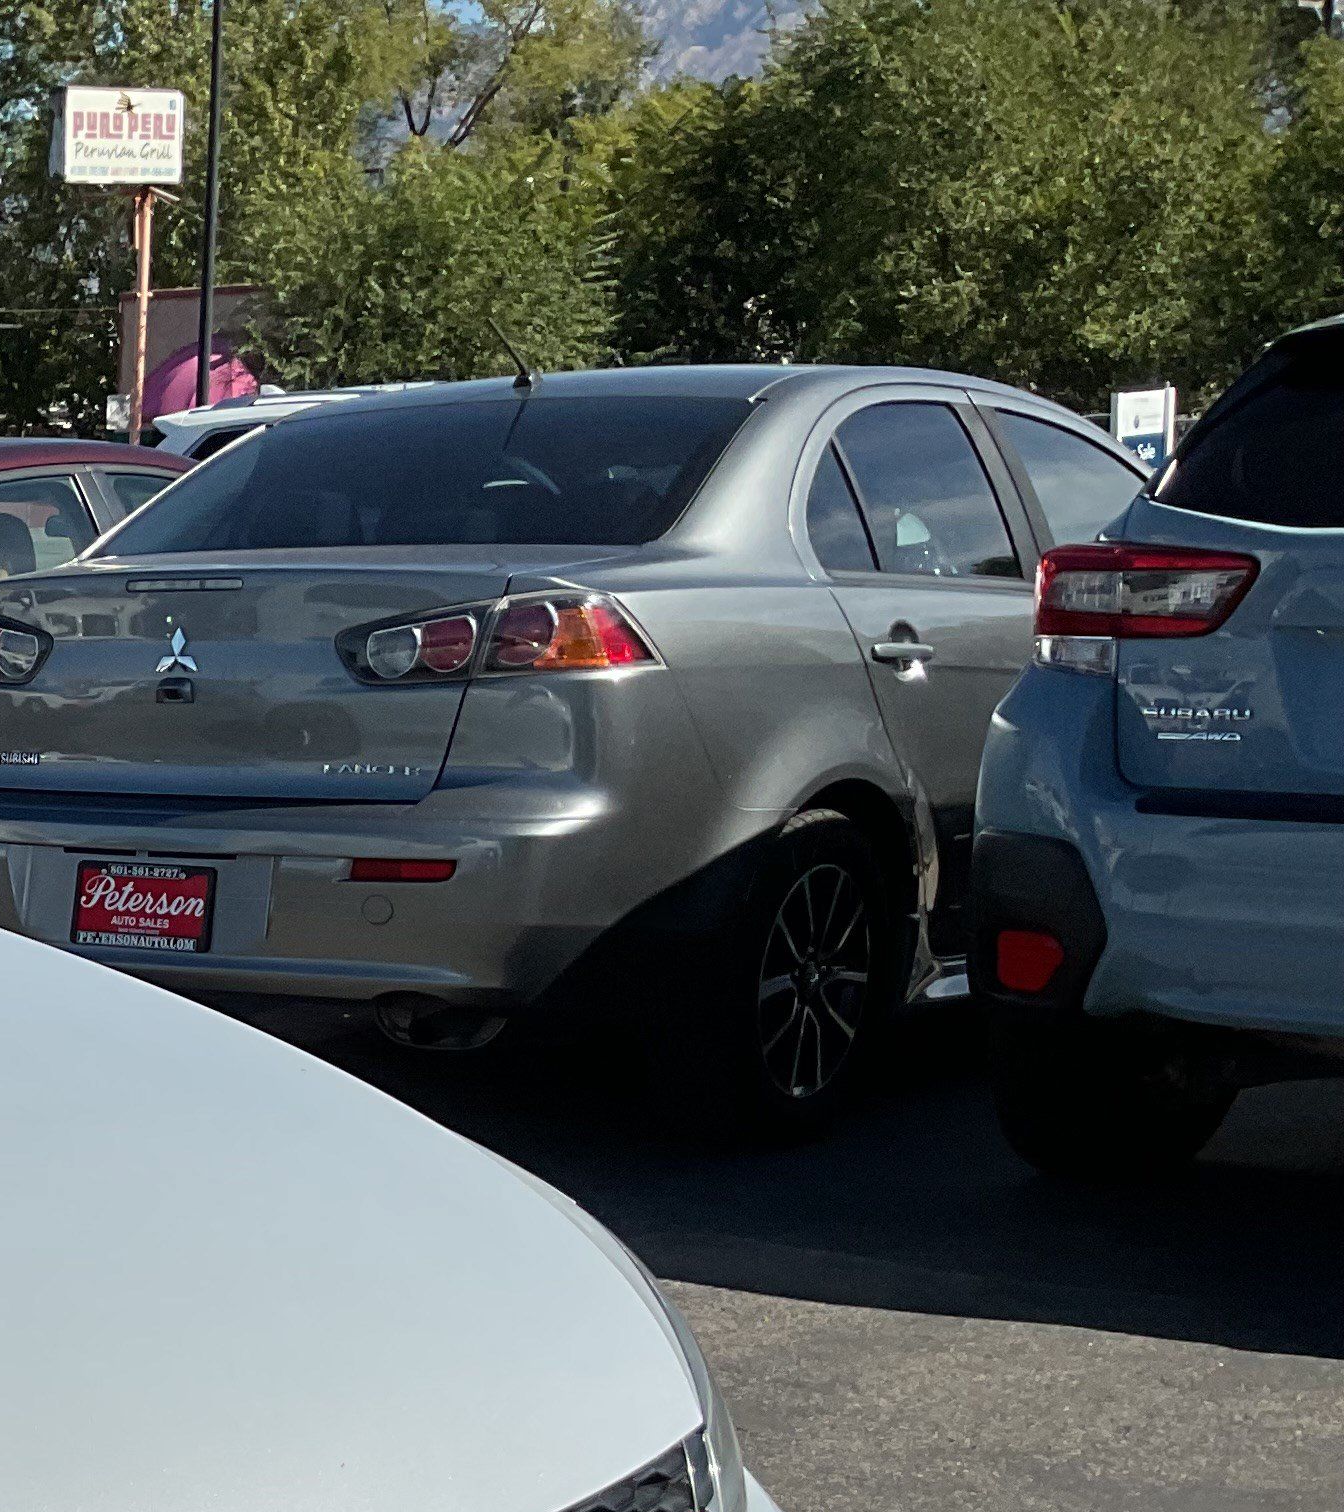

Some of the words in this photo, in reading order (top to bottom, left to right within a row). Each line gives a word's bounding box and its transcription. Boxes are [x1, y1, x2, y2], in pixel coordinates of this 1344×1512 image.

[72, 111, 123, 139] PURO
[127, 112, 176, 140] PERU
[74, 141, 137, 160] Peruvian
[139, 142, 172, 160] Grill
[1141, 707, 1251, 721] SUBARU
[110, 864, 179, 879] 801-561-2727
[79, 874, 205, 917] Peterson
[111, 915, 136, 926] AUTO
[139, 917, 170, 929] SALES
